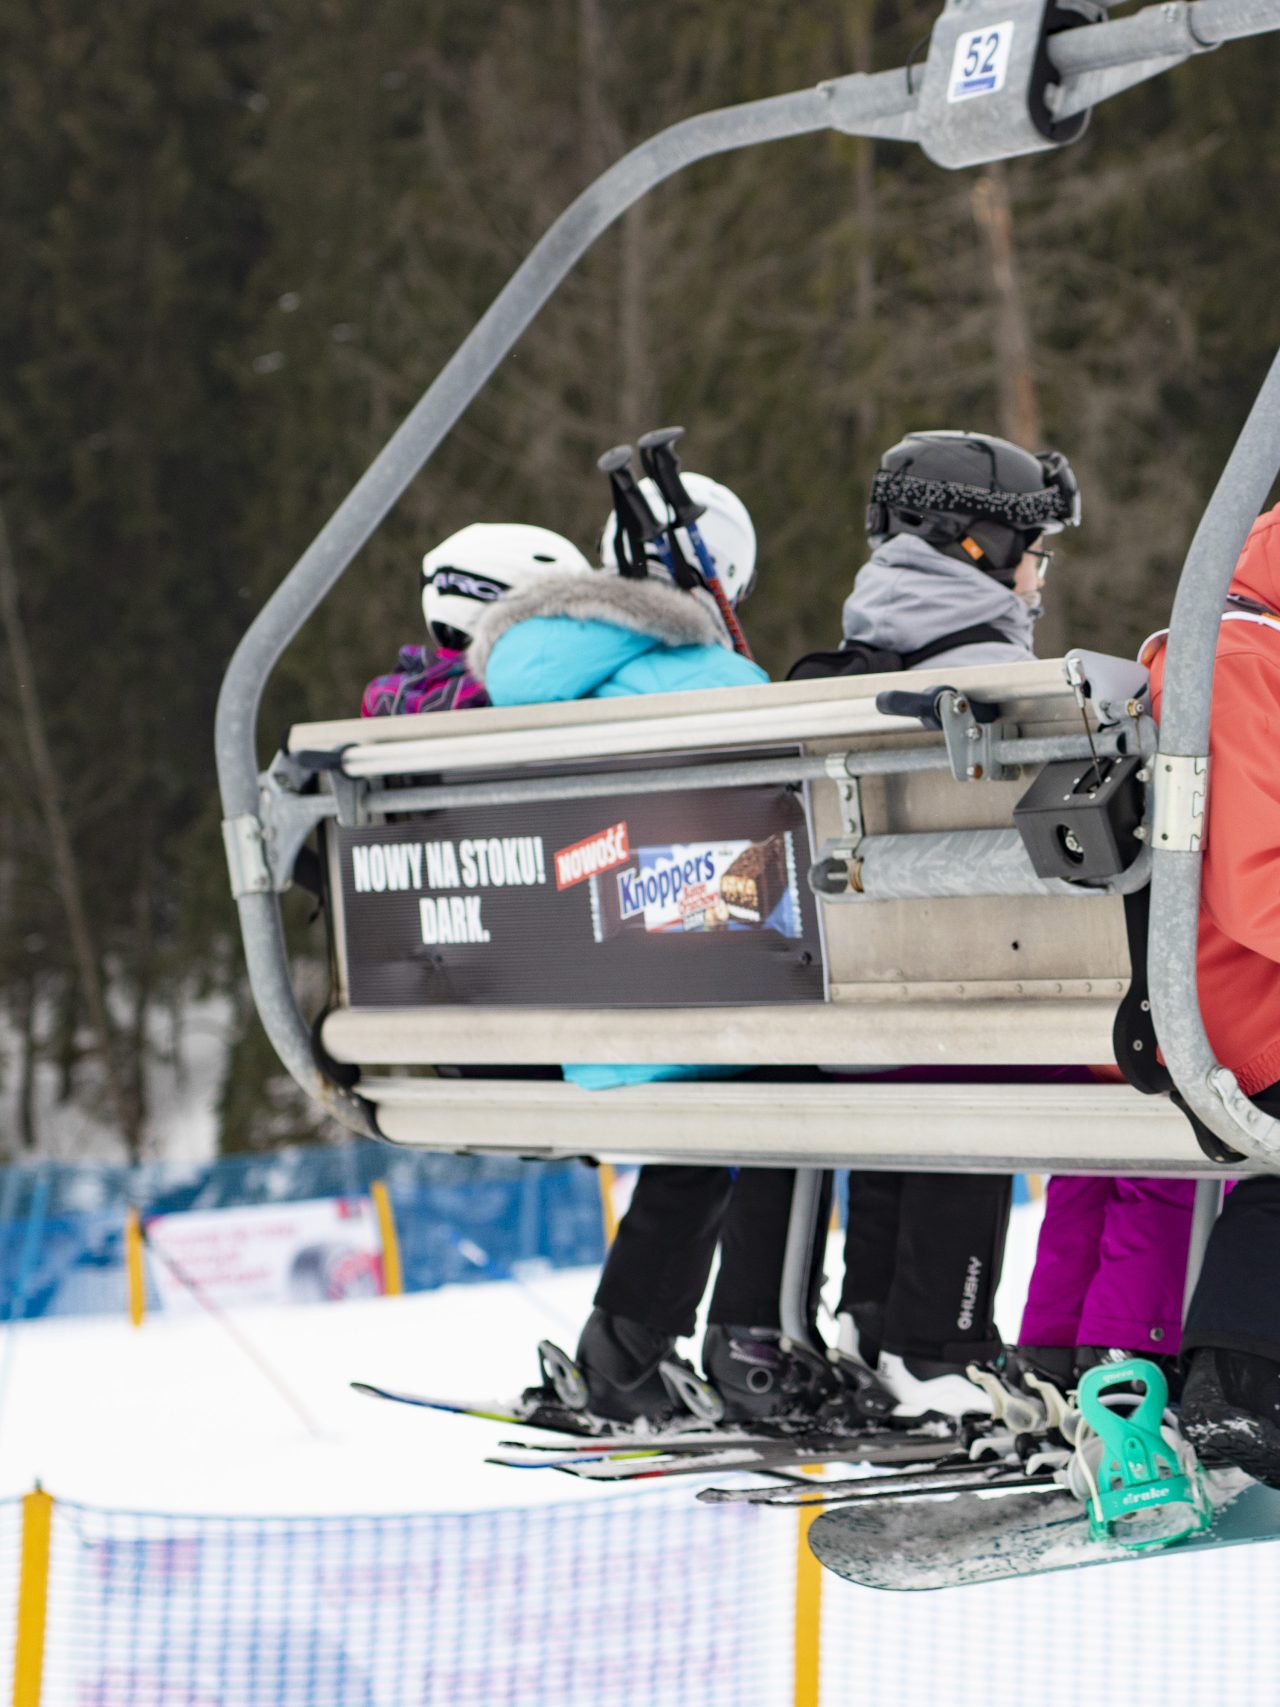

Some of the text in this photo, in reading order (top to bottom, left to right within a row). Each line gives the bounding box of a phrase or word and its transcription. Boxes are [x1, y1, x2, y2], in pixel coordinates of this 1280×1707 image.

[963, 32, 1000, 77] 52
[352, 837, 546, 892] NOWY NA STOKU!
[557, 822, 627, 885] NOWOŚĆ
[619, 850, 715, 915] Knoppers
[419, 896, 490, 944] DARK.
[1122, 1487, 1170, 1505] drake
